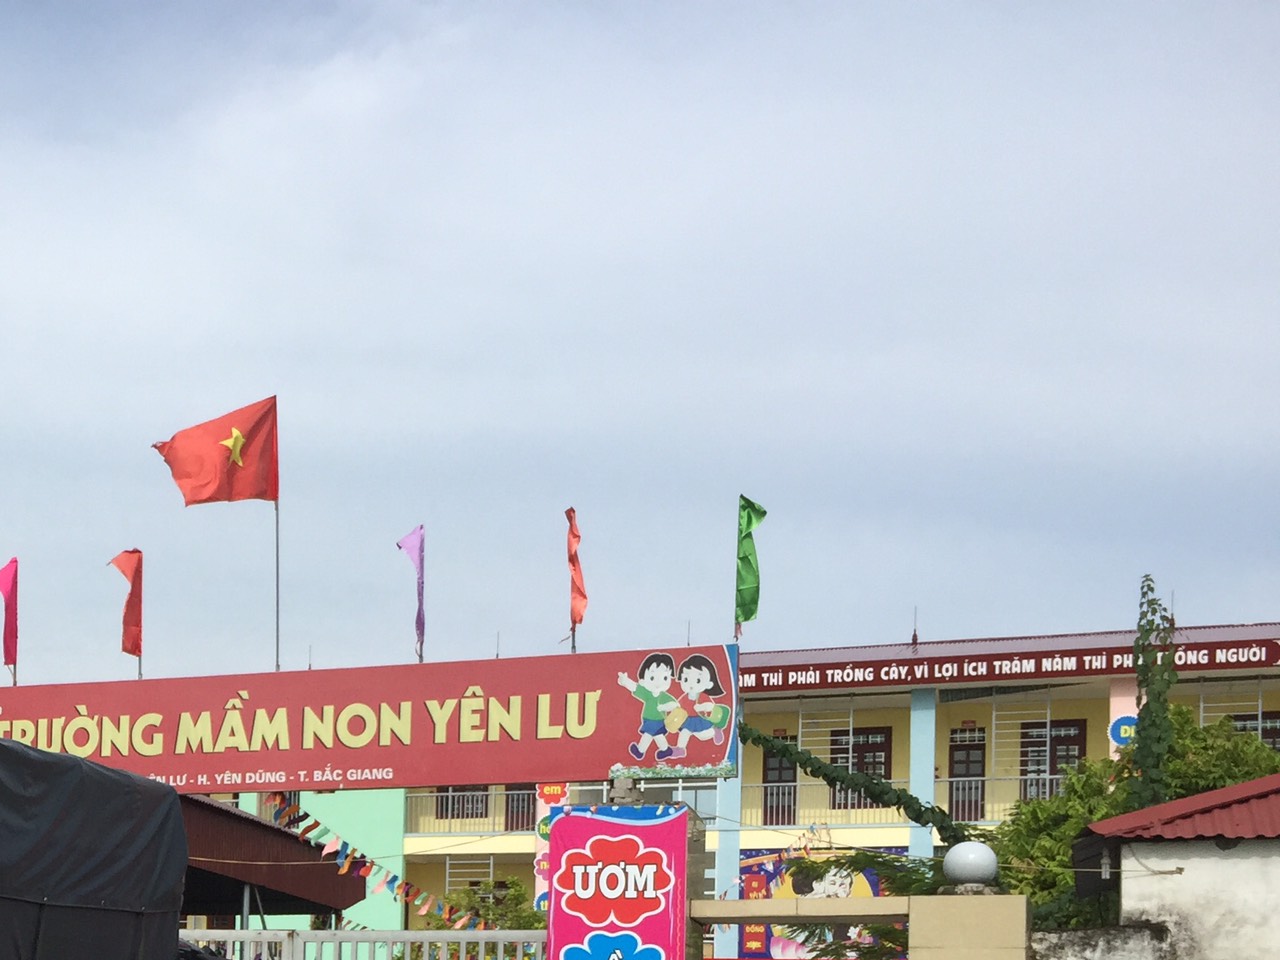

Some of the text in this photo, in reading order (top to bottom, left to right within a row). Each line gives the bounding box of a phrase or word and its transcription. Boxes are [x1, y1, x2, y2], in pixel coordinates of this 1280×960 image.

[761, 671, 783, 686] THÌ
[788, 668, 821, 685] PHẢI
[826, 663, 874, 683] TRỒNG
[934, 662, 958, 681] LỢI
[963, 659, 988, 677] ÍCH
[993, 655, 1035, 675] TRĂM
[1041, 653, 1077, 672] NĂM
[1082, 651, 1107, 670] THÌ
[1156, 645, 1209, 666] TỒNG
[1215, 643, 1267, 663] NGƯỜI
[174, 690, 290, 755] MẦM
[302, 701, 412, 749] NON
[425, 685, 521, 744] YÊN
[536, 689, 602, 739] LƯ
[197, 774, 210, 785] H.
[215, 771, 242, 784] YÊN
[245, 769, 286, 784] DŨNG
[298, 771, 309, 782] T.
[313, 764, 343, 781] BẮC
[346, 768, 394, 780] GIANG
[543, 785, 561, 795] em
[572, 861, 657, 899] ƯƠM
